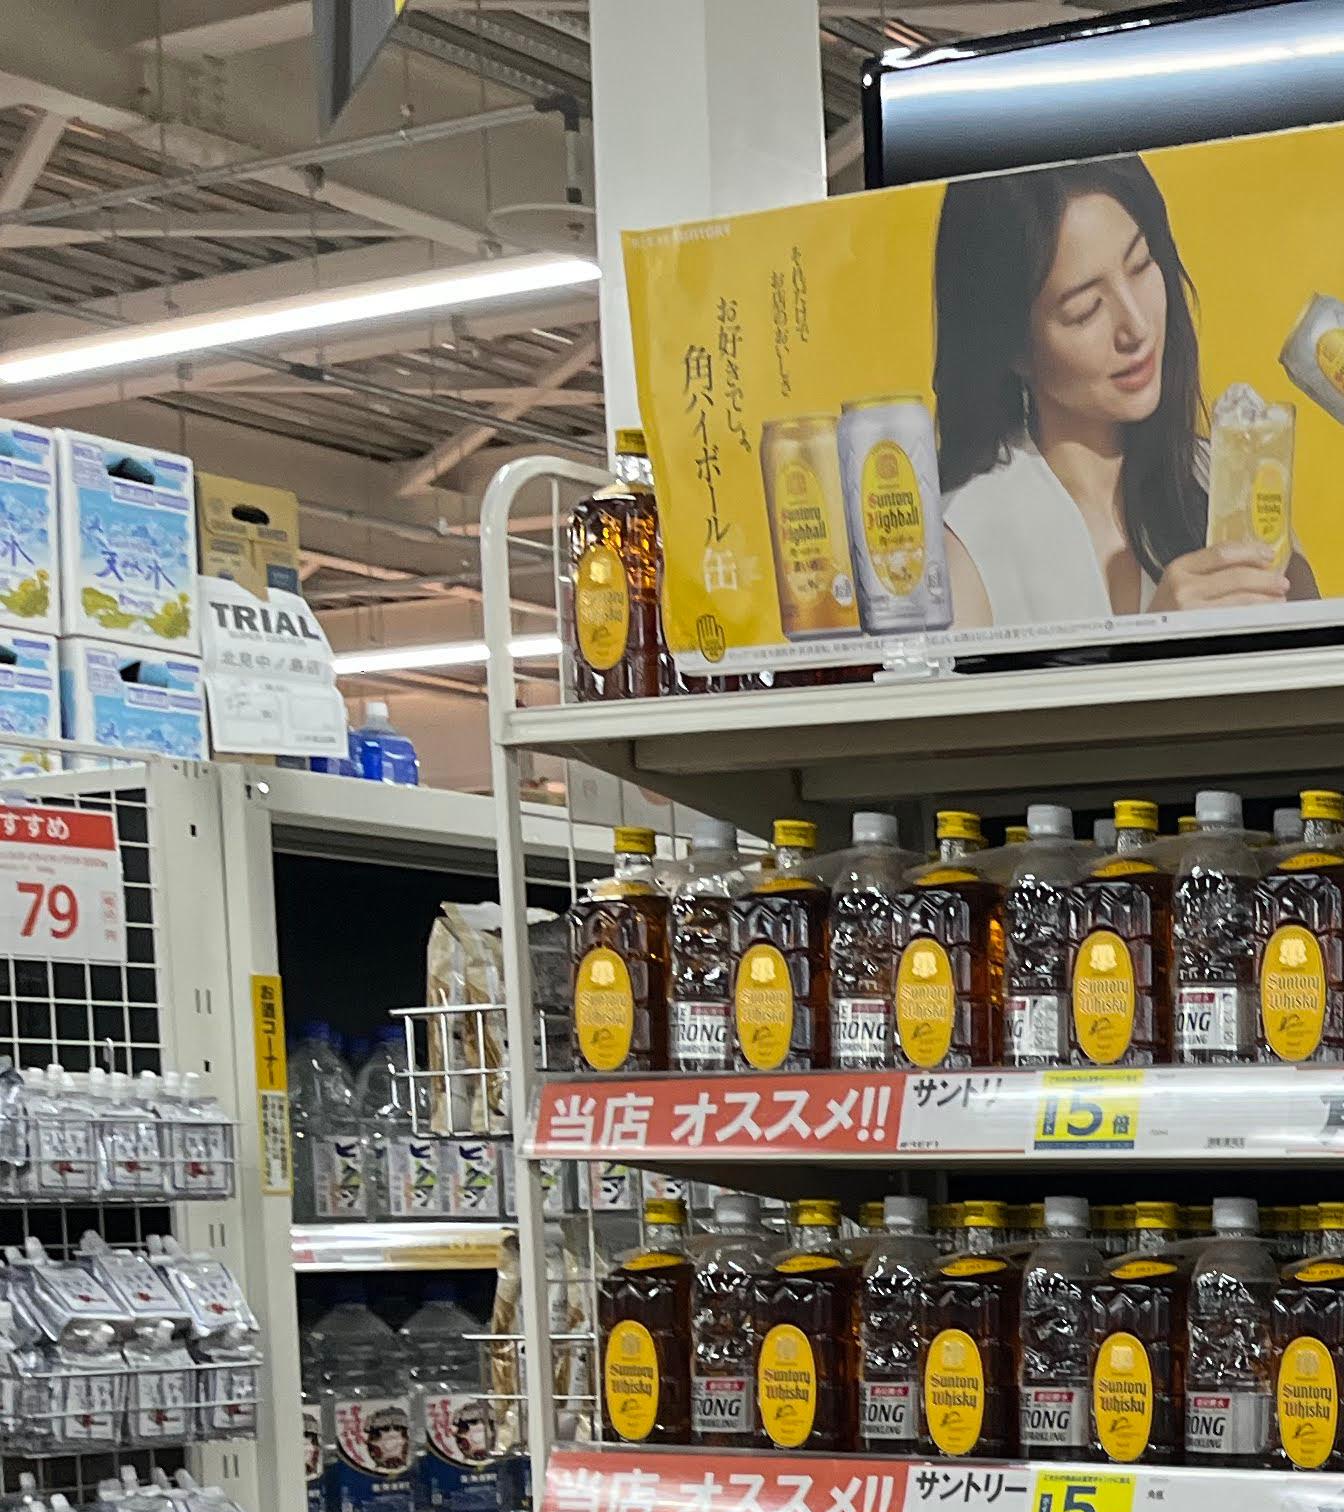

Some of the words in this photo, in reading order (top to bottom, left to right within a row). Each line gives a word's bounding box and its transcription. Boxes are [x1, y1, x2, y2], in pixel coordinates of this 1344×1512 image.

[209, 601, 322, 641] TRIAL
[0, 812, 70, 840] すすめ
[610, 1363, 653, 1380] Suntory
[764, 1368, 811, 1386] Suntory
[612, 1378, 653, 1396] Whisky
[931, 1372, 978, 1391] Suntory
[1098, 1379, 1147, 1397] Suntory
[766, 1384, 809, 1403] Whisky
[932, 1390, 977, 1409] Whisky
[1283, 1382, 1332, 1402] Suntory
[1100, 1396, 1145, 1415] Whisky
[1284, 1400, 1330, 1420] Whisky
[916, 1471, 1028, 1502] サントリー
